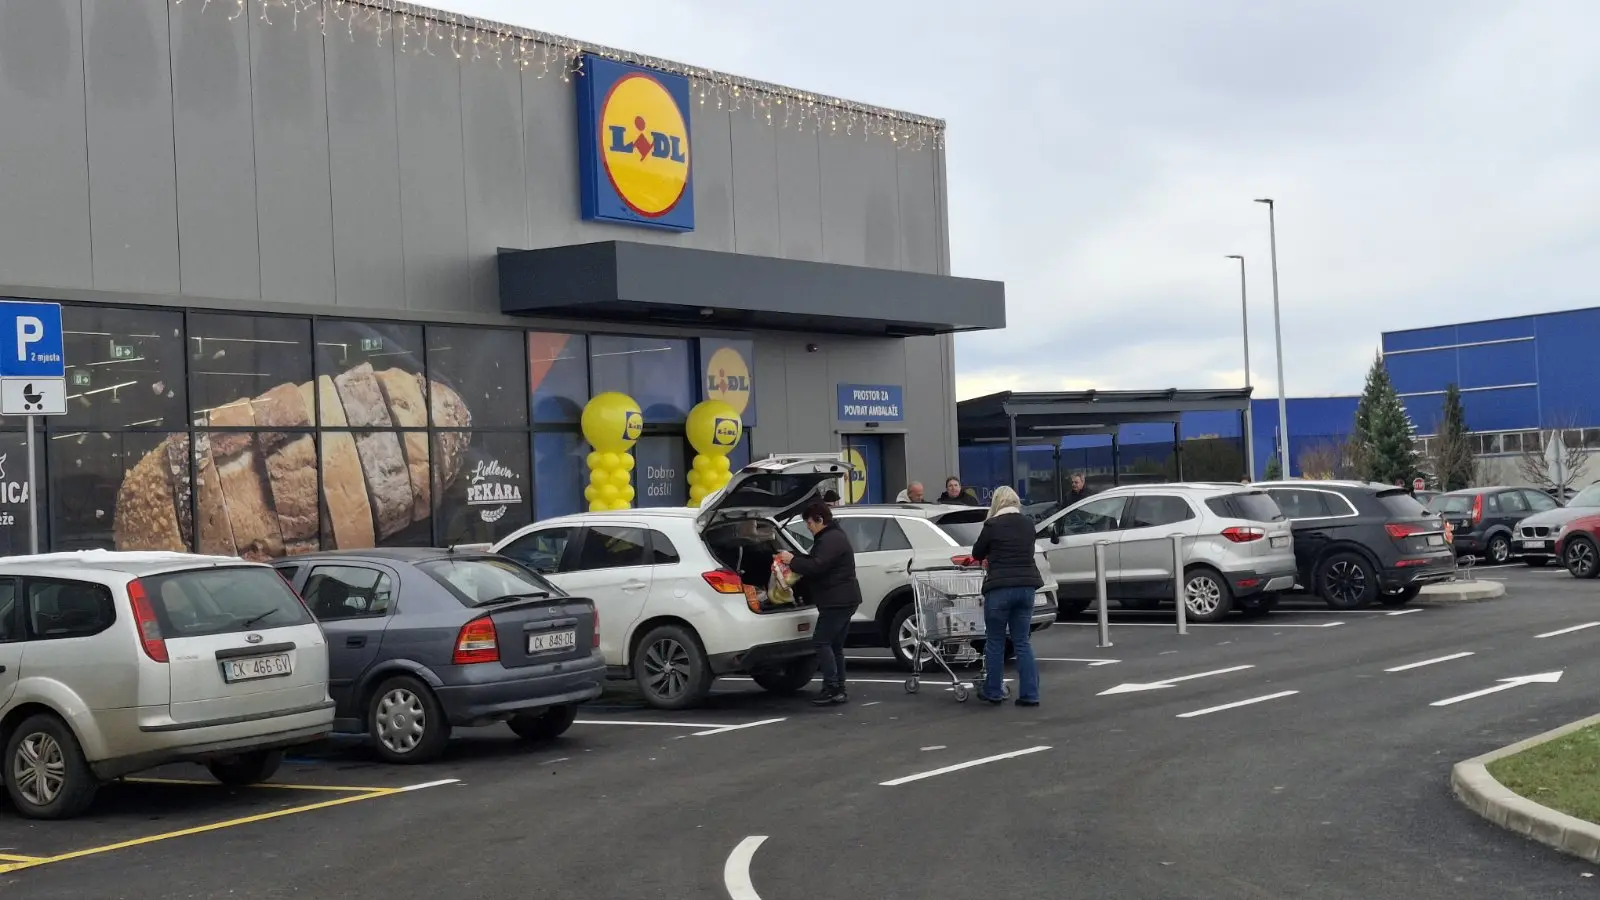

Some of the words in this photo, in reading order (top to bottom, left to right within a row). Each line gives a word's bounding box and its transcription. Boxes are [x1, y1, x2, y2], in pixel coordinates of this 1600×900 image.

[16, 315, 44, 361] P
[31, 352, 36, 361] 2
[37, 353, 60, 364] mjesta
[853, 390, 880, 401] PROSTOR
[881, 391, 889, 401] ZA
[844, 405, 868, 416] POVRAT
[869, 404, 899, 417] AMBALAŽE
[471, 460, 513, 484] Lidlova
[647, 465, 675, 479] Dobro
[467, 482, 522, 501] PEKARA
[647, 482, 672, 497] došli!
[535, 636, 544, 649] CK
[232, 662, 246, 678] CK
